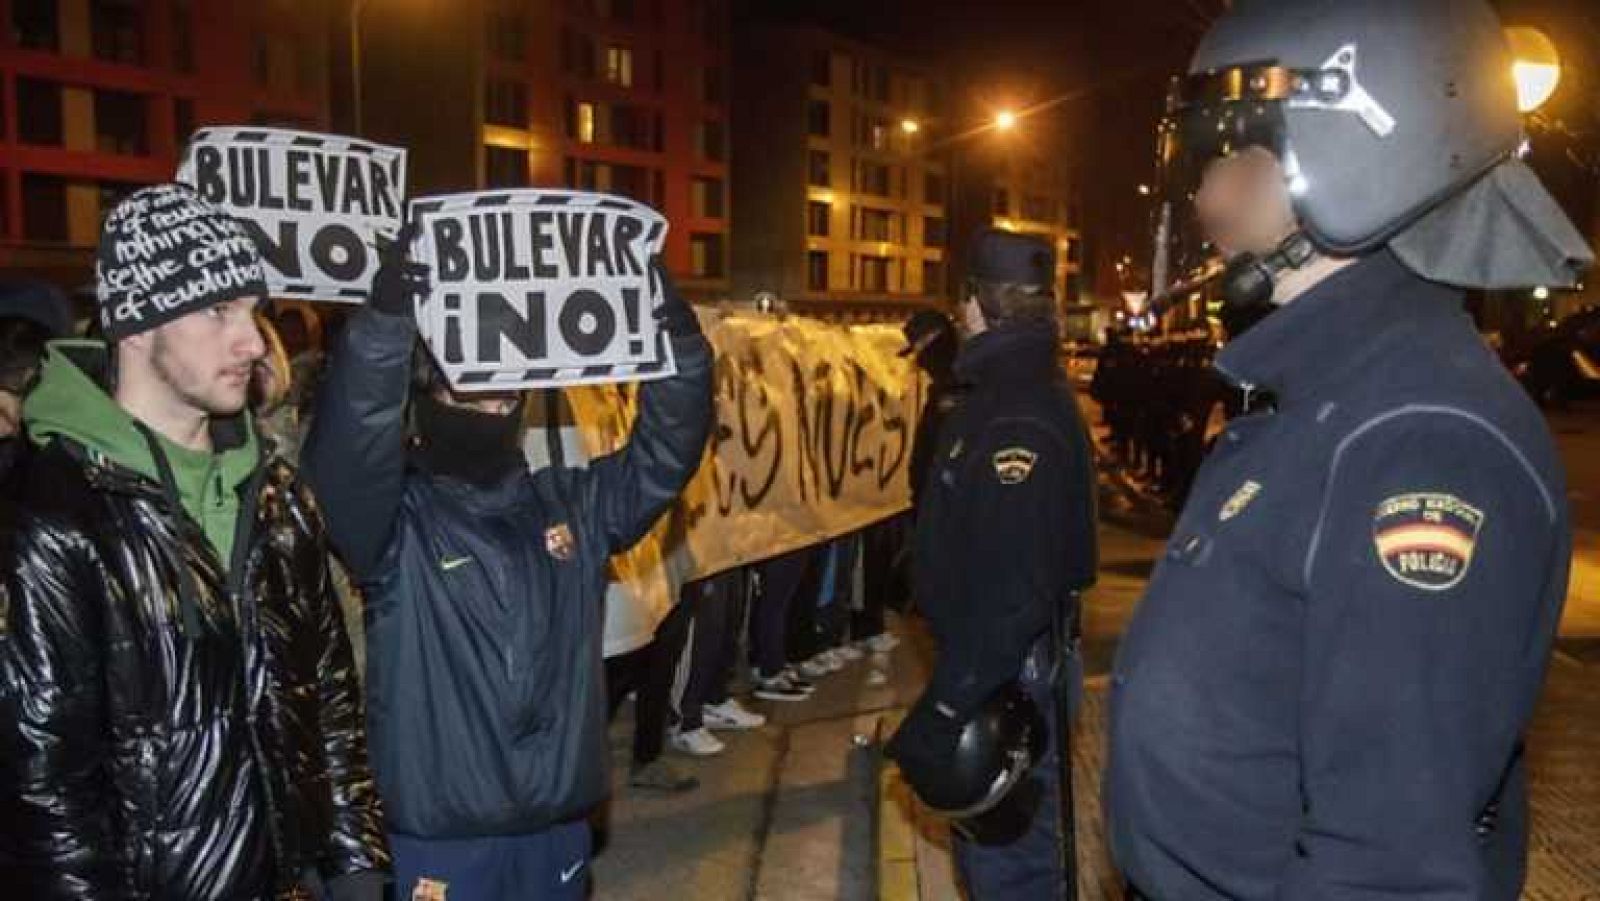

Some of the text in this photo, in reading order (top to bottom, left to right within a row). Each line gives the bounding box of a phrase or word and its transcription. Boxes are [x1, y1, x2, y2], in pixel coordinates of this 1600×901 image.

[197, 146, 399, 217] BULEVAR
[433, 211, 643, 282] BULEVAR
[444, 288, 642, 363] ¡NO!
